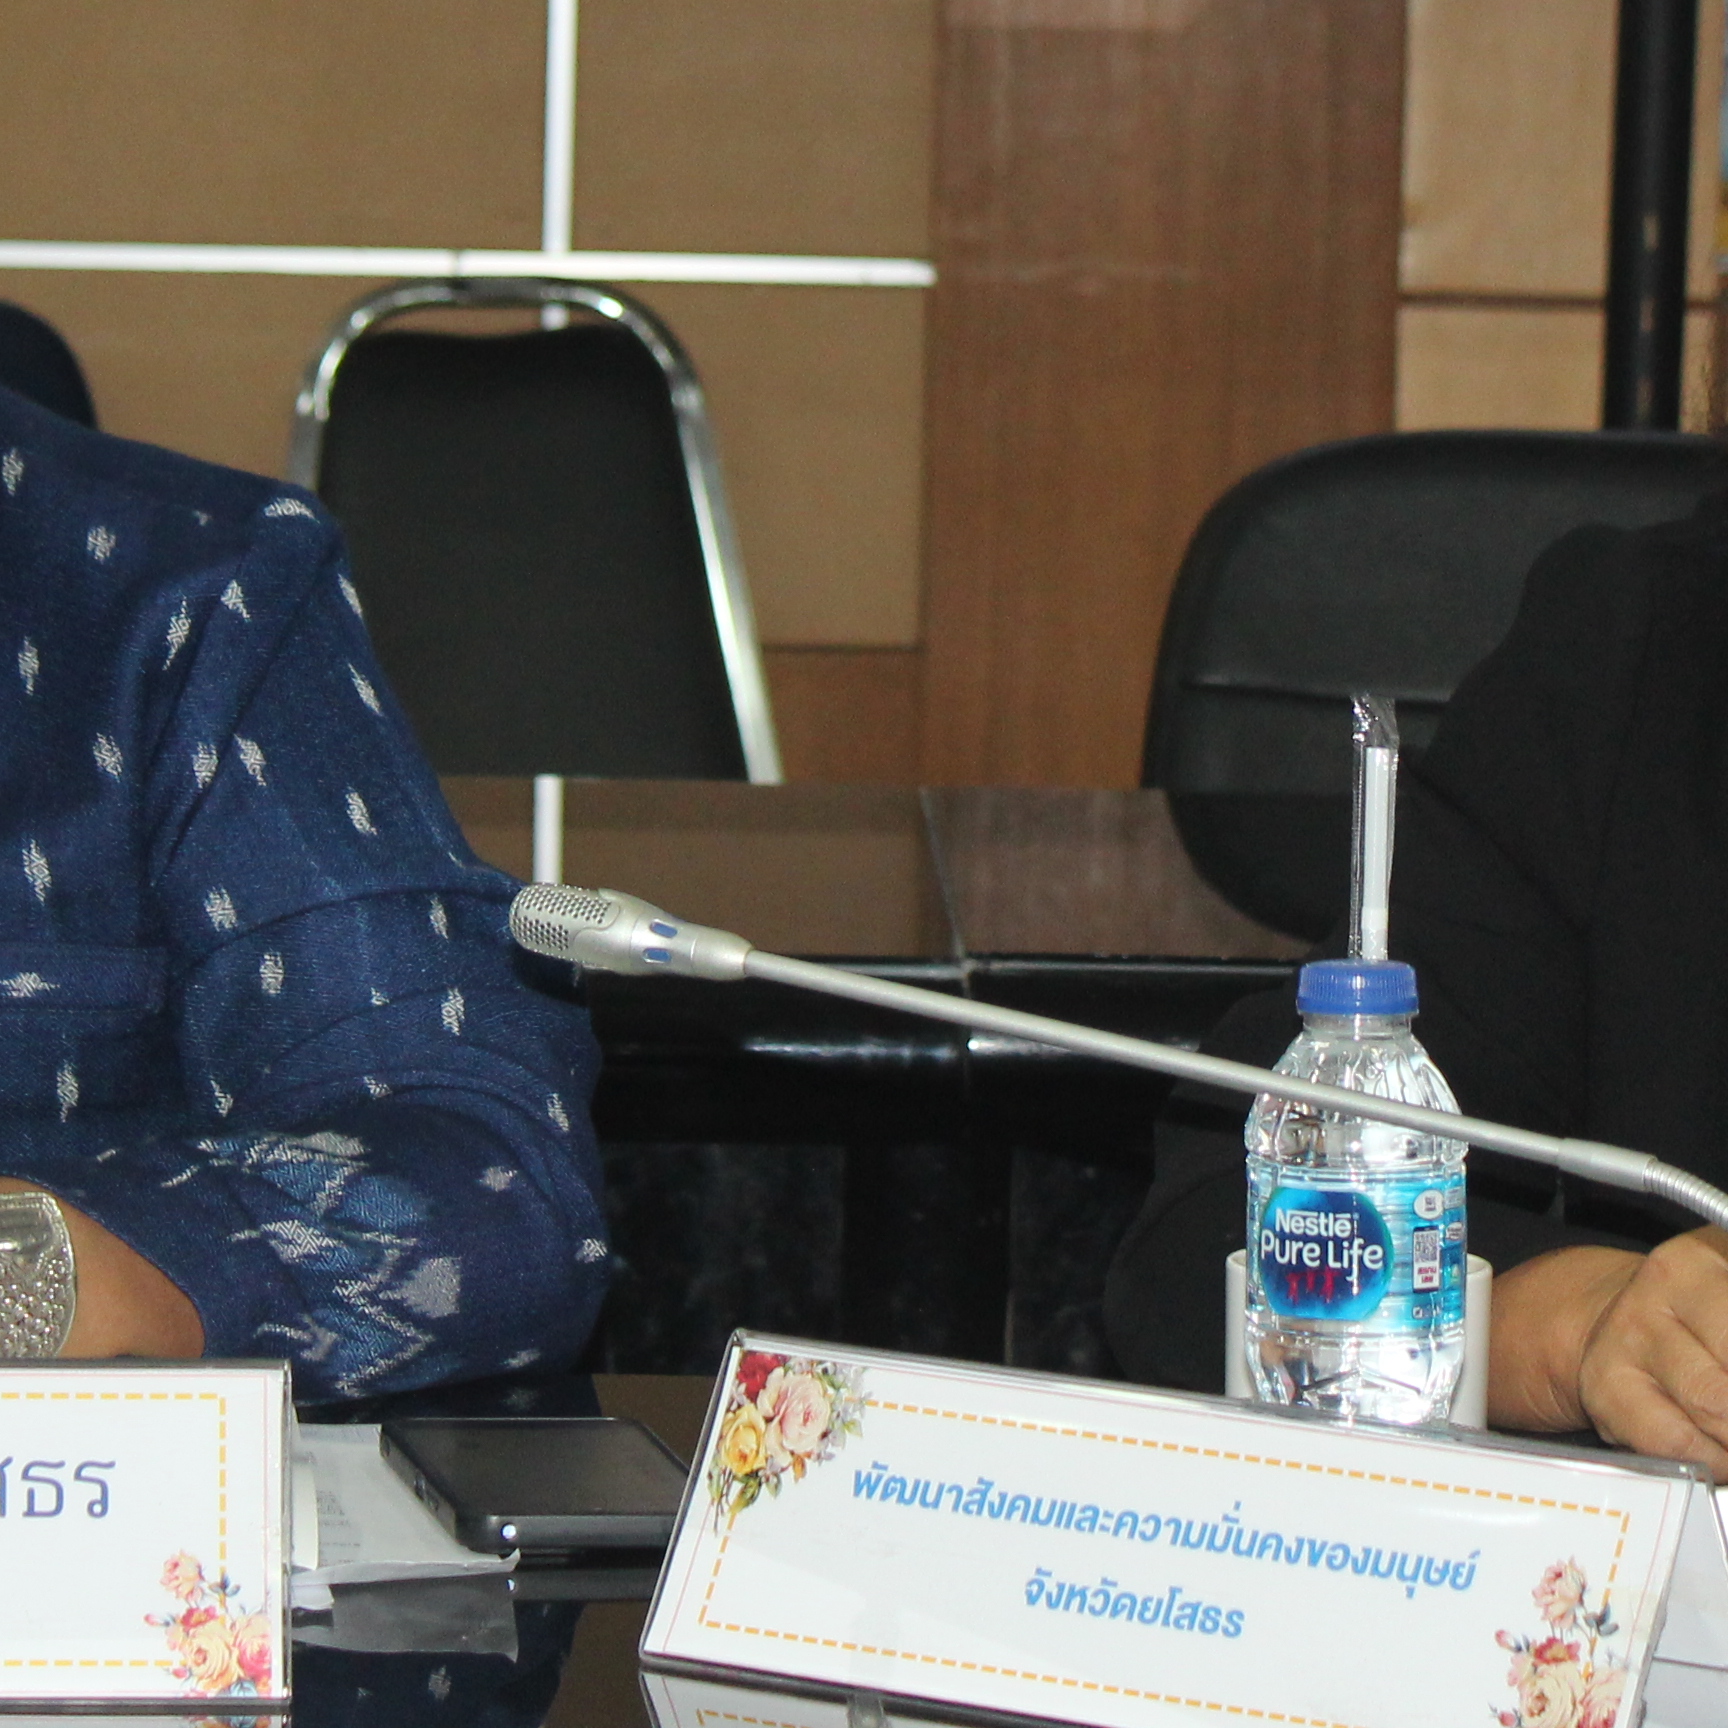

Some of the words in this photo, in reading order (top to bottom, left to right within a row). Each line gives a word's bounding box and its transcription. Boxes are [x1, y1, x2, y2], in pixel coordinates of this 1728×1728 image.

[1260, 1229, 1321, 1267] Pure
[1327, 1237, 1385, 1282] Life
[850, 1460, 1481, 1600] พัฒนาสังคมและความมั่นคงของมนุษย์
[1023, 1568, 1246, 1642] จังหวัดยโสธร
